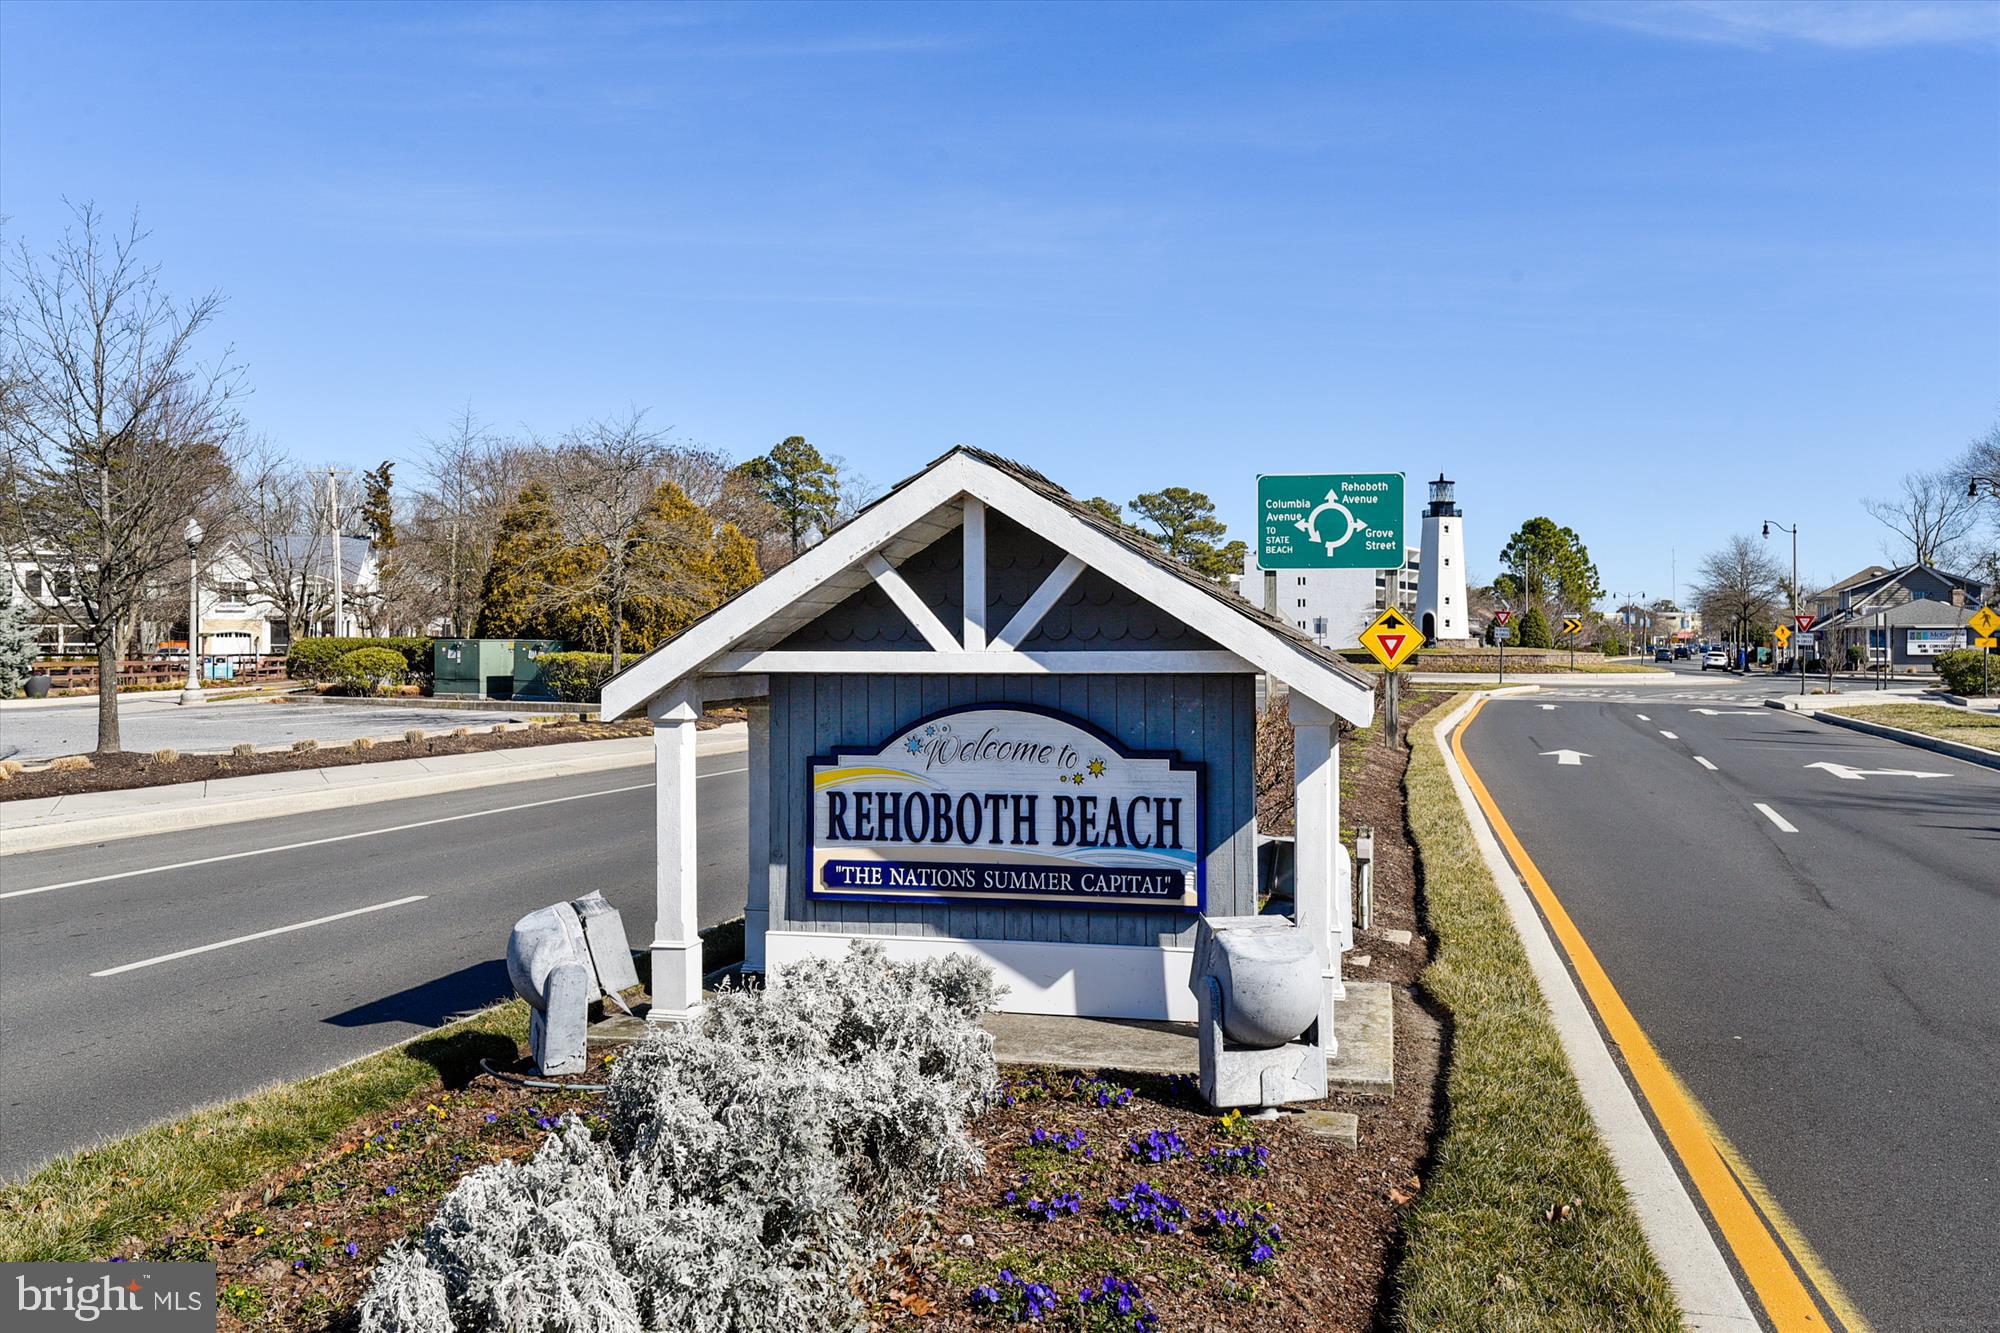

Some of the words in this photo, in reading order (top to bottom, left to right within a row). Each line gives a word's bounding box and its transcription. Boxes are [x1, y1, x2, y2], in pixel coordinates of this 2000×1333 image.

[1341, 482, 1388, 492] Rehoboth
[1265, 499, 1311, 509] Columbia
[1342, 494, 1378, 504] Avenue
[1266, 512, 1302, 521] Avenue
[1265, 526, 1276, 535] TO
[1365, 528, 1394, 538] Grove
[1265, 536, 1290, 544] STATE
[1365, 540, 1396, 550] Street
[1265, 546, 1293, 554] BEACH
[924, 727, 1053, 770] Welcome
[1058, 744, 1078, 769] to
[826, 790, 1039, 846] REHOBOTH
[1052, 795, 1183, 849] BEACH
[835, 865, 882, 885] "THE
[889, 867, 976, 888] NATION'S
[984, 870, 1072, 891] SUMMER
[1081, 873, 1171, 895] CAPITAL"
